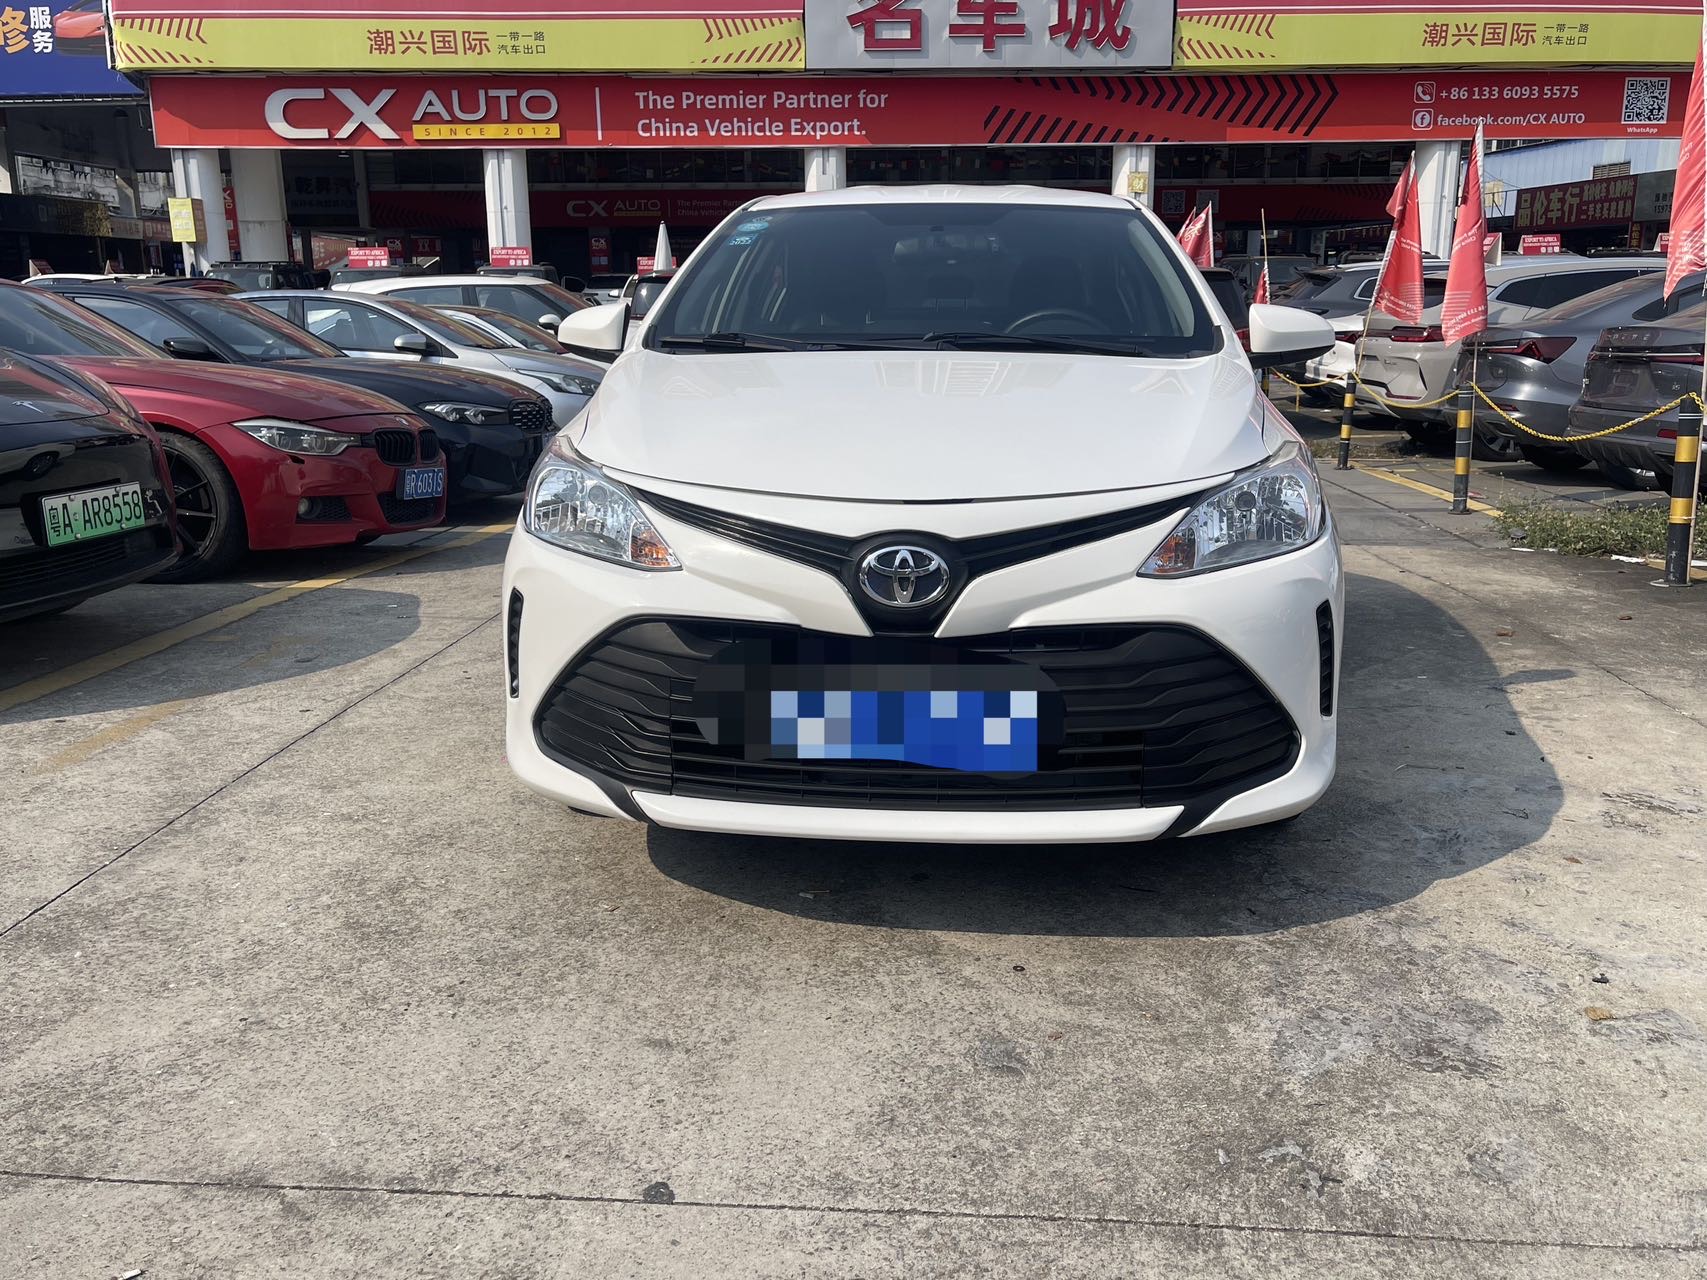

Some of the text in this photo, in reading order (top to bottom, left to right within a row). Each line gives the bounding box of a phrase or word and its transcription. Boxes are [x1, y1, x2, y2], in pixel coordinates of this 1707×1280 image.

[29, 7, 53, 53] 服务
[846, 0, 1131, 51] 名车城
[1422, 22, 1537, 47] 潮兴国际
[1544, 23, 1590, 34] 一带一路
[366, 29, 491, 55] 潮兴国际
[496, 31, 545, 42] 一带一路
[1542, 35, 1587, 46] 汽车出口
[497, 44, 546, 55] 汽车出口
[635, 89, 888, 109] The Premier Partner for
[1440, 85, 1579, 100] +86 133 6093 5575
[264, 88, 559, 140] CX AUTO
[1550, 113, 1585, 125] AUTO
[425, 127, 551, 136] SINCE 2012
[637, 117, 866, 139] China Vehicle Export.
[566, 200, 609, 217] CX
[613, 200, 661, 211] AUTO
[1518, 187, 1580, 226] 品伦车行
[82, 490, 141, 532] AR8558
